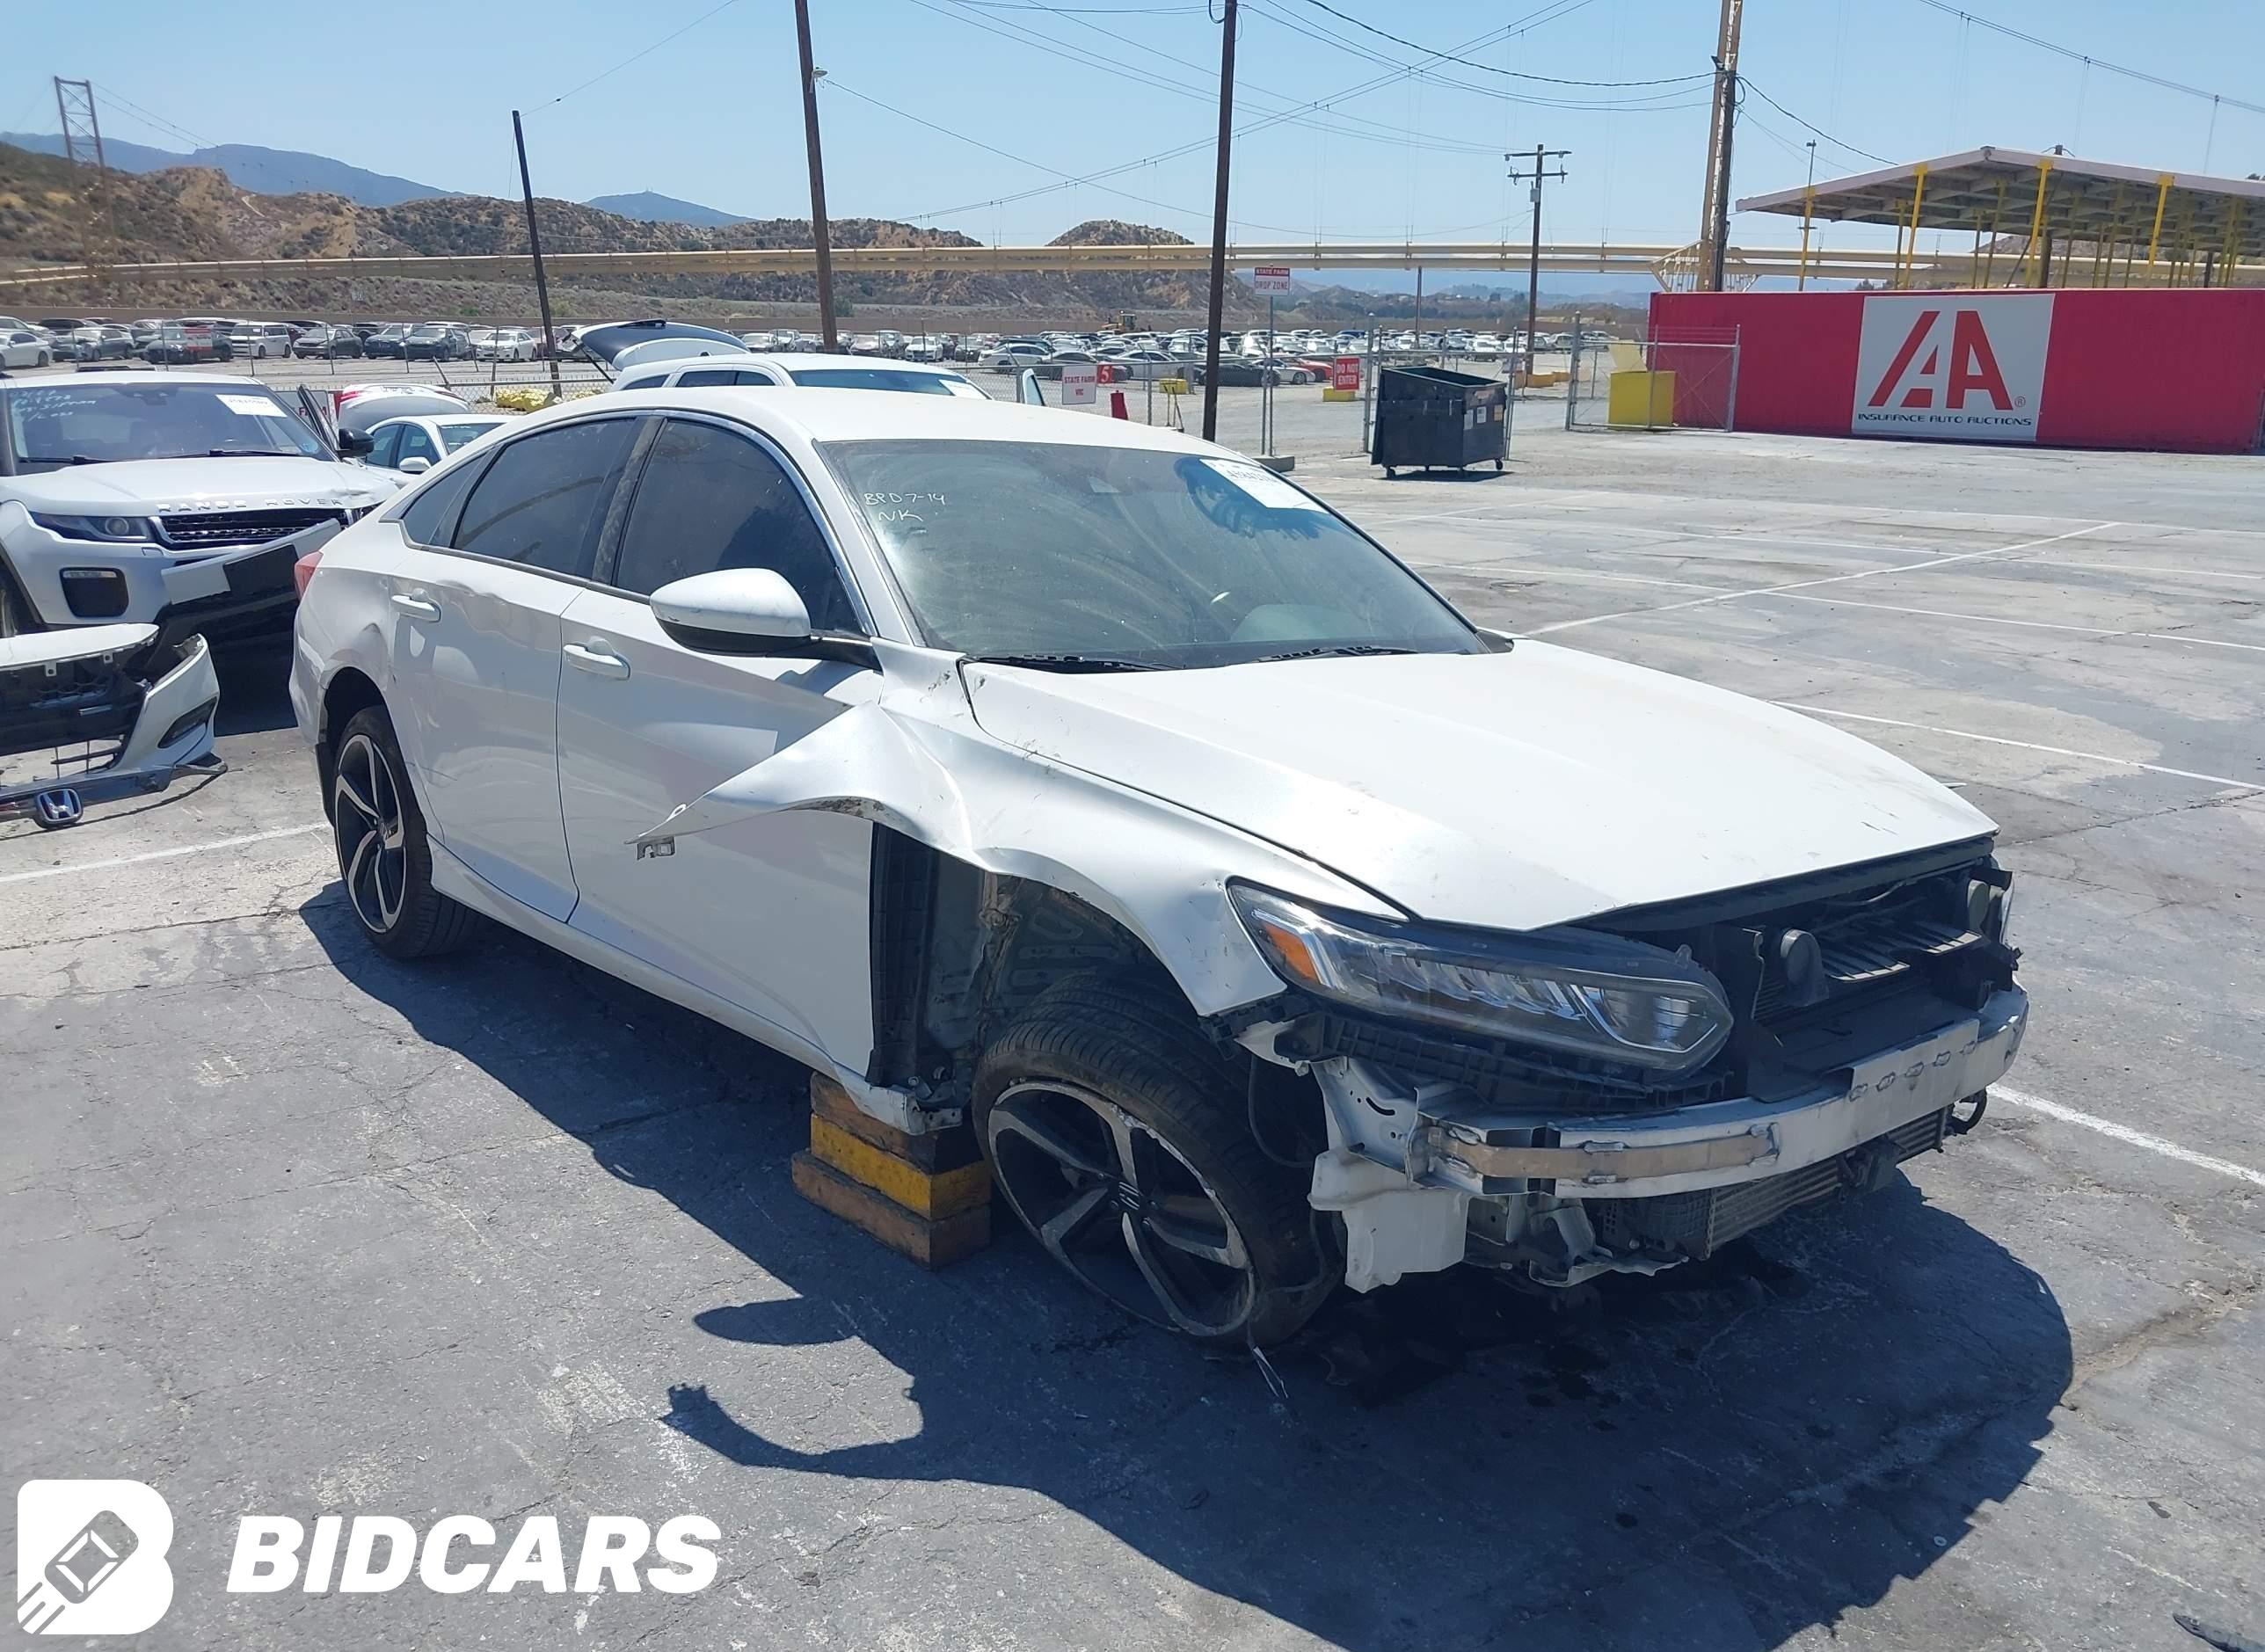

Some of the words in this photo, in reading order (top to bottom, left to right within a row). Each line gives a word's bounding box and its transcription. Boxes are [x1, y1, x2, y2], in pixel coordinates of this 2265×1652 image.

[1255, 280, 1271, 289] DROP
[1272, 281, 1288, 290] ZONE
[1100, 365, 1110, 383] 5
[1336, 364, 1346, 374] DO
[1346, 363, 1358, 374] NOT
[1337, 375, 1358, 385] ENTER
[1857, 412, 1925, 423] INSURANCE
[1929, 414, 1963, 424] AUTO
[1967, 416, 2033, 426] AUCTIONS
[156, 499, 247, 513] RANGE
[265, 498, 343, 506] ROVER
[904, 492, 945, 506] 7-14
